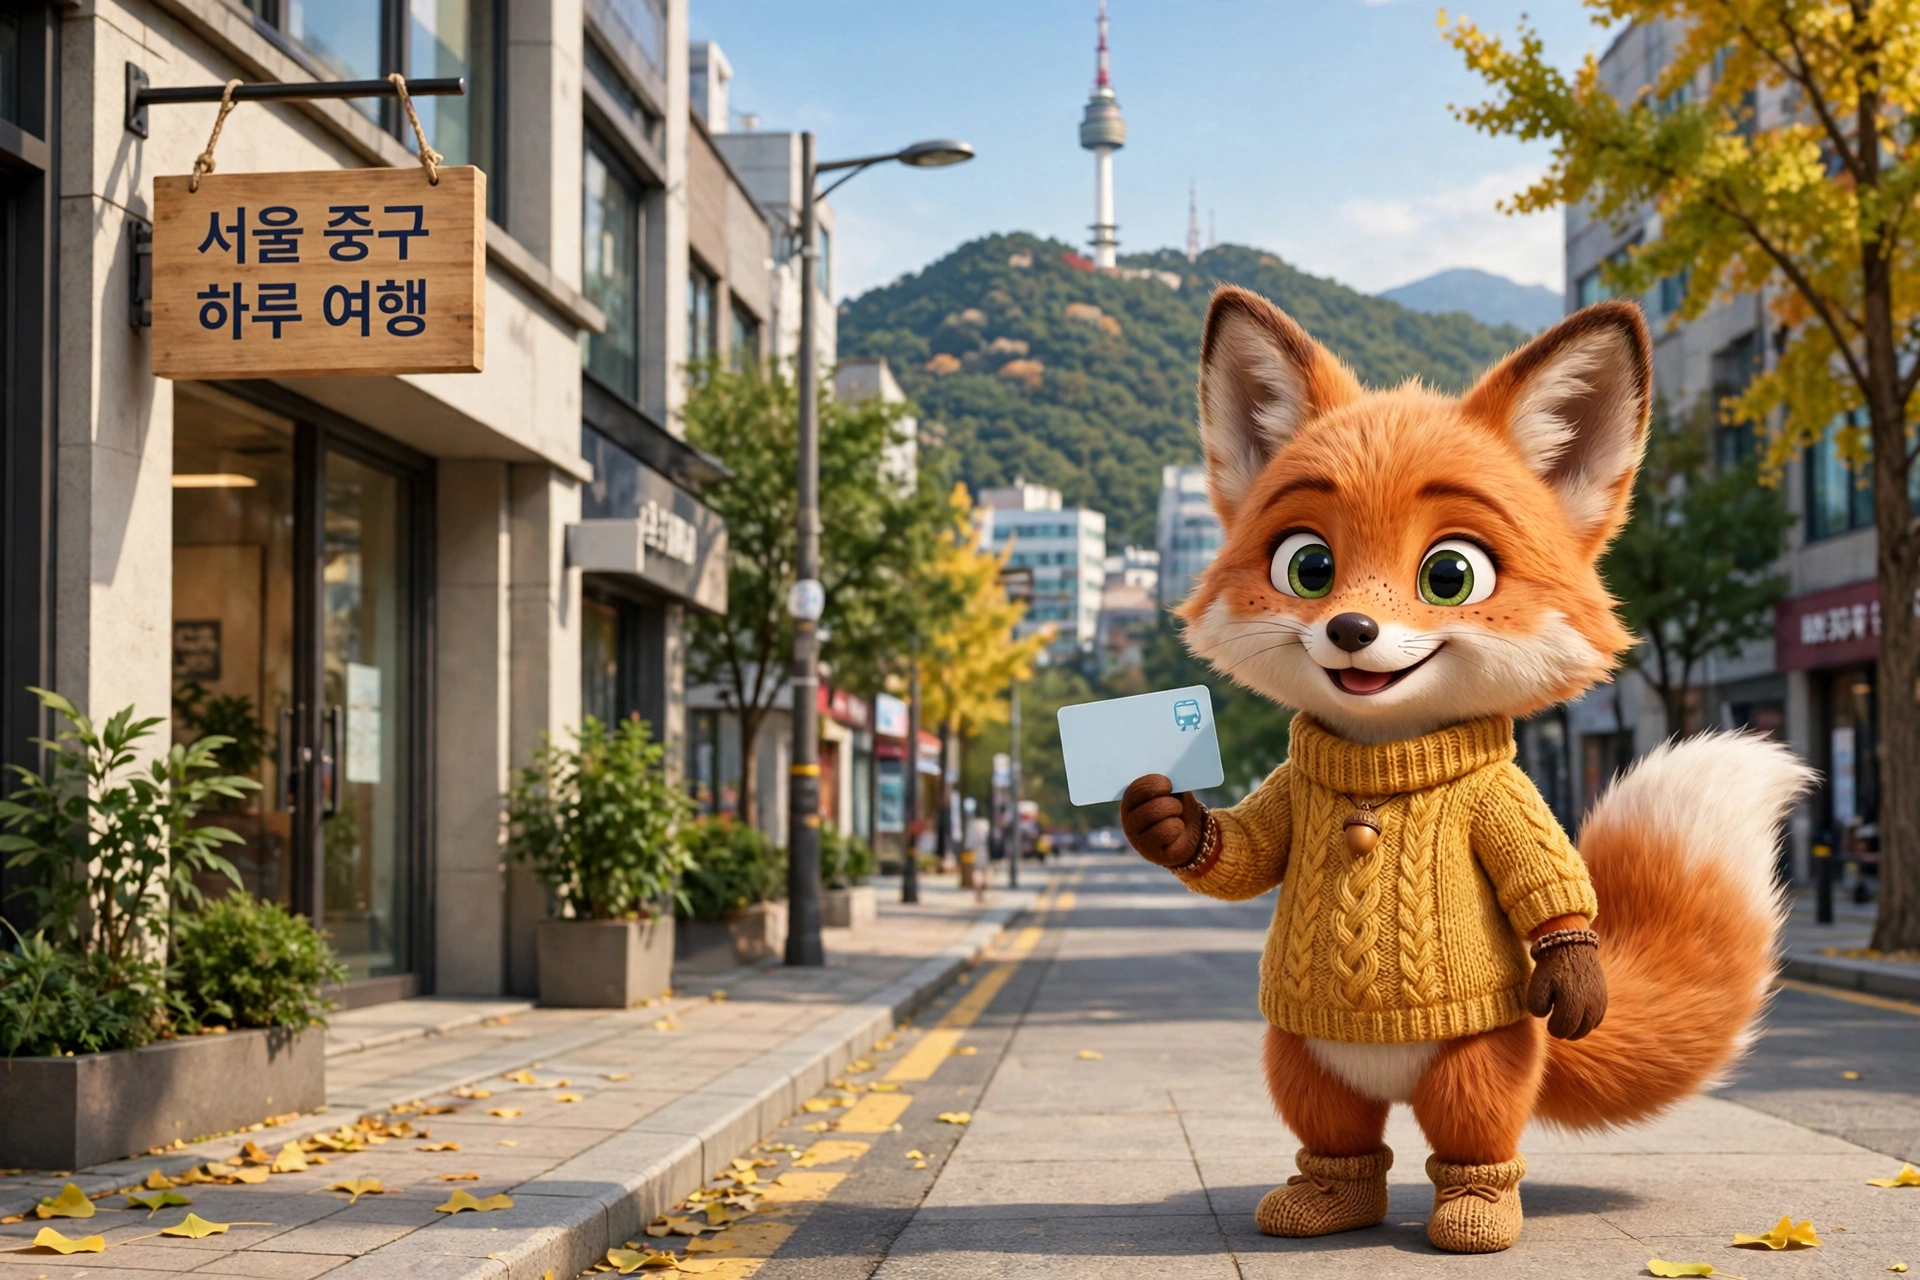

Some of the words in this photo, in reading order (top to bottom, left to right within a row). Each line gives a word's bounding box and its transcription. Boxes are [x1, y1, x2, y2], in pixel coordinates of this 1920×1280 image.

[197, 206, 304, 264] 서울
[323, 204, 429, 262] 중구
[196, 281, 303, 340] 하루
[323, 278, 427, 337] 여행
